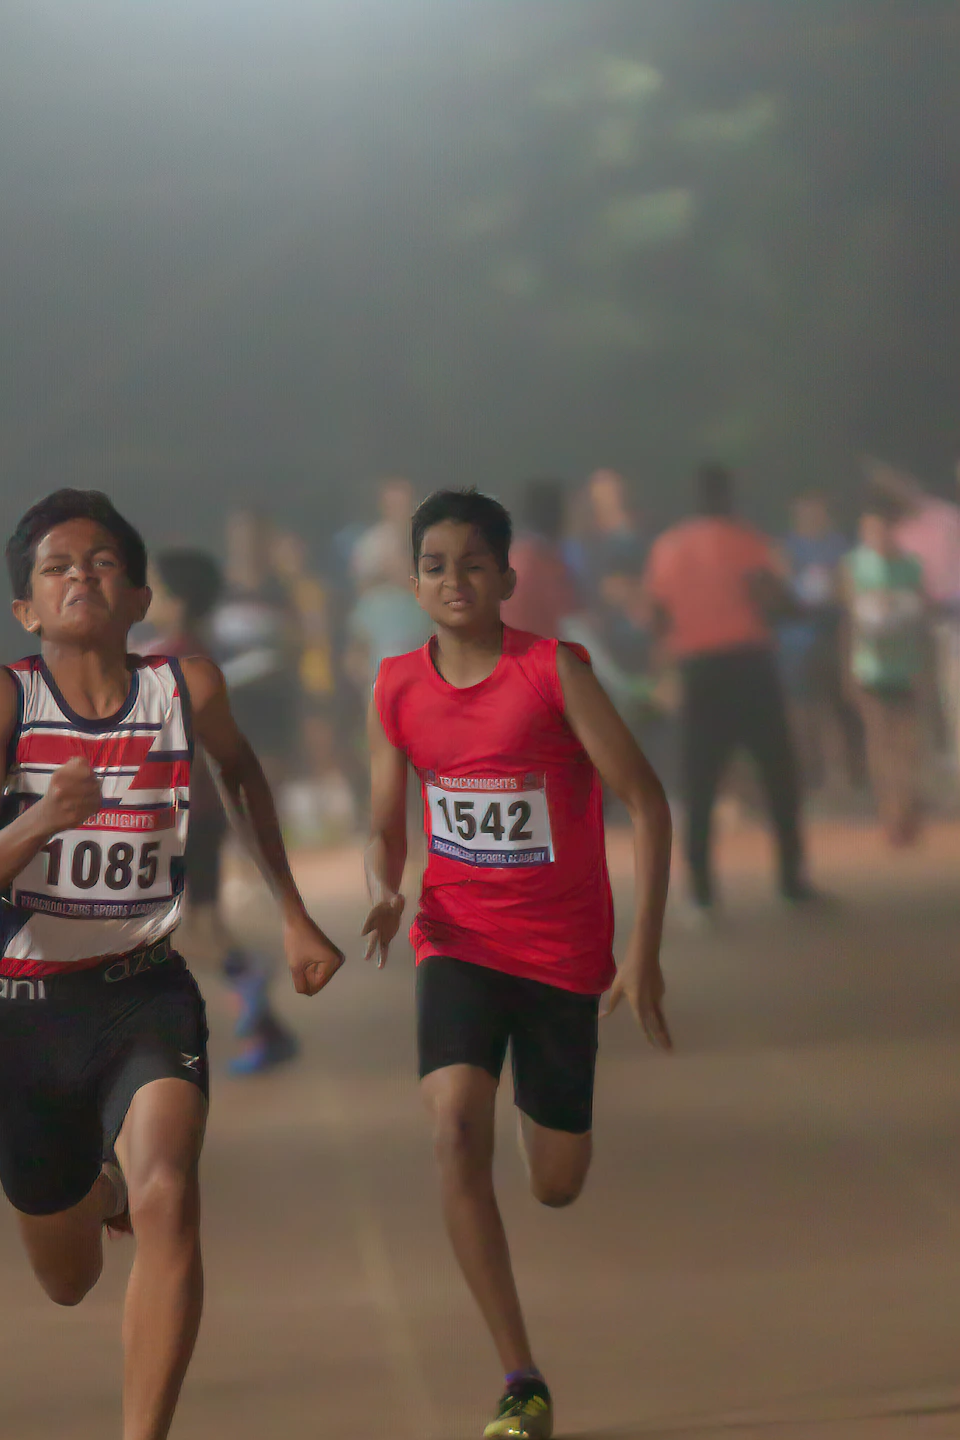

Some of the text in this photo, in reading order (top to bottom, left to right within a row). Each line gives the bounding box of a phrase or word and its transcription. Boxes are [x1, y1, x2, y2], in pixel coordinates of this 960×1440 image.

[439, 776, 518, 790] TRACKNIGHTS
[82, 812, 155, 829] CKNIGHTS
[437, 796, 533, 841] 1542
[40, 838, 161, 891] 1085
[93, 904, 129, 917] SPORTS
